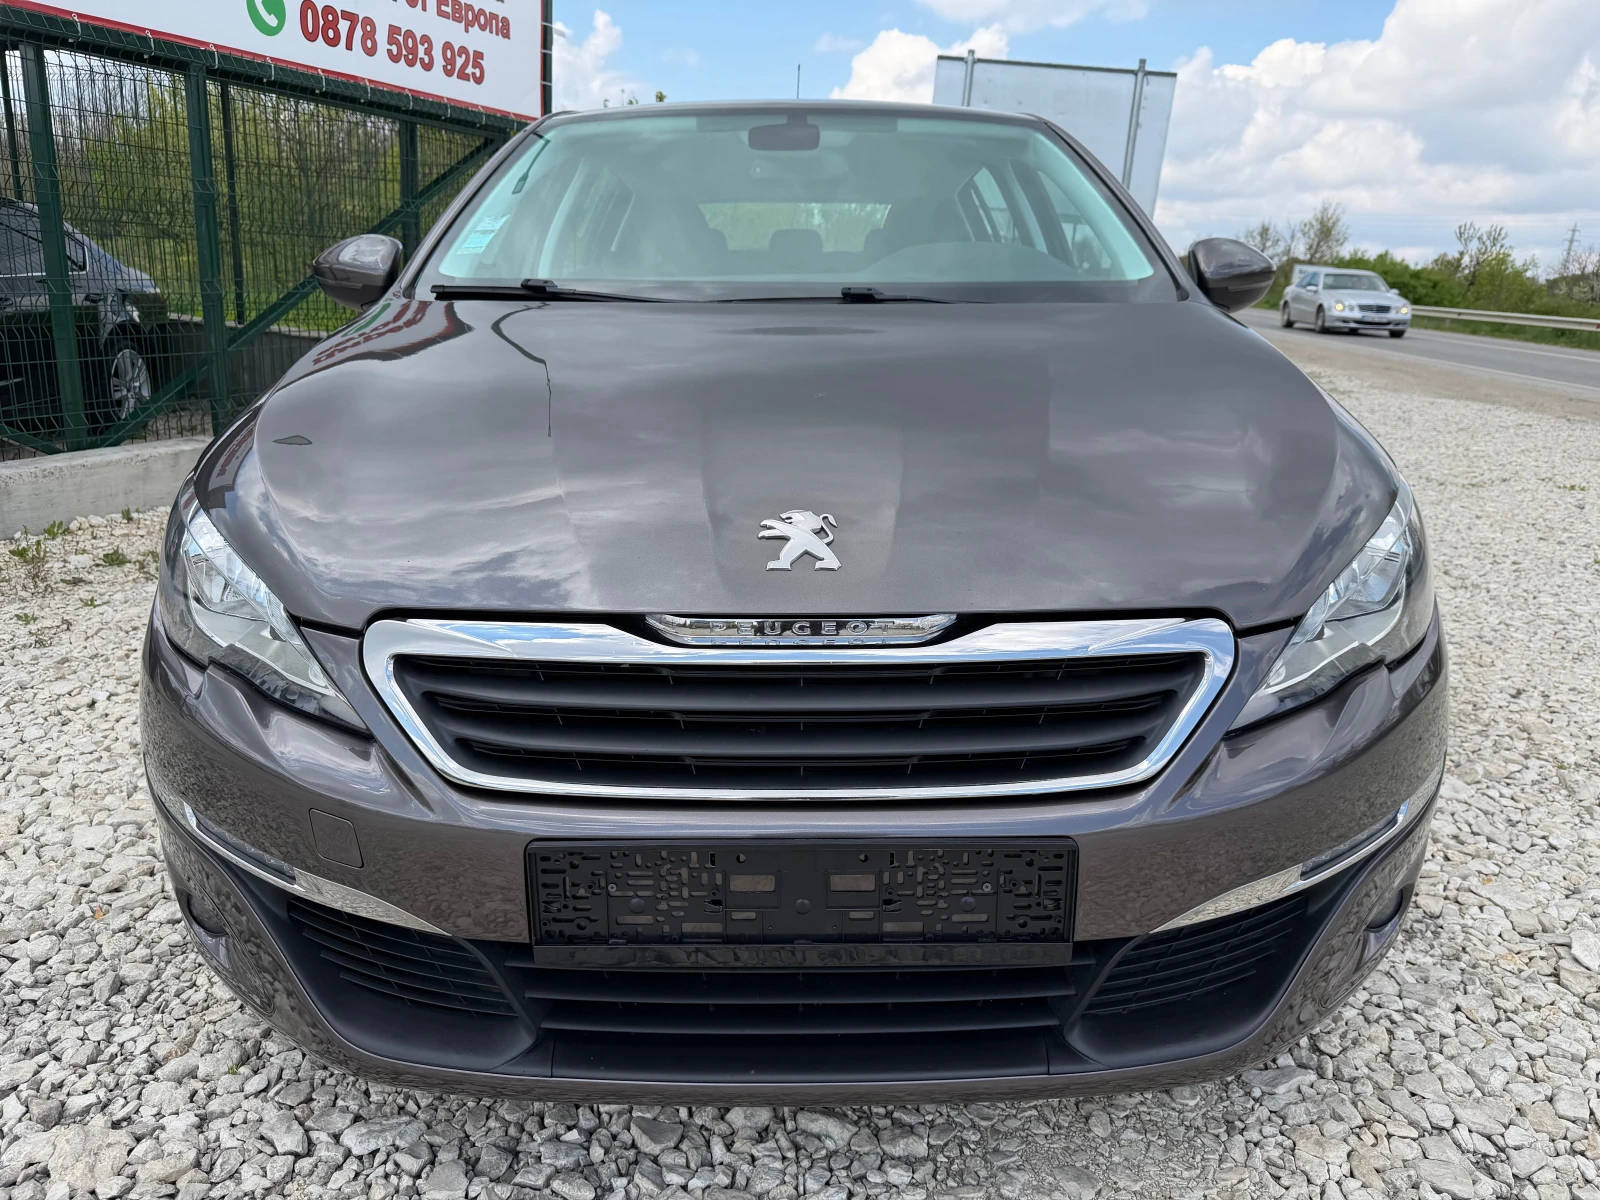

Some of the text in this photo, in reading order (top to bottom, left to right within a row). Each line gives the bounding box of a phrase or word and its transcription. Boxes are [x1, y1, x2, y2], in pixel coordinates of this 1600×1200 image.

[436, 0, 511, 40] Европа
[300, 0, 485, 85] 0878 593 925
[709, 620, 895, 636] PEUGEOT
